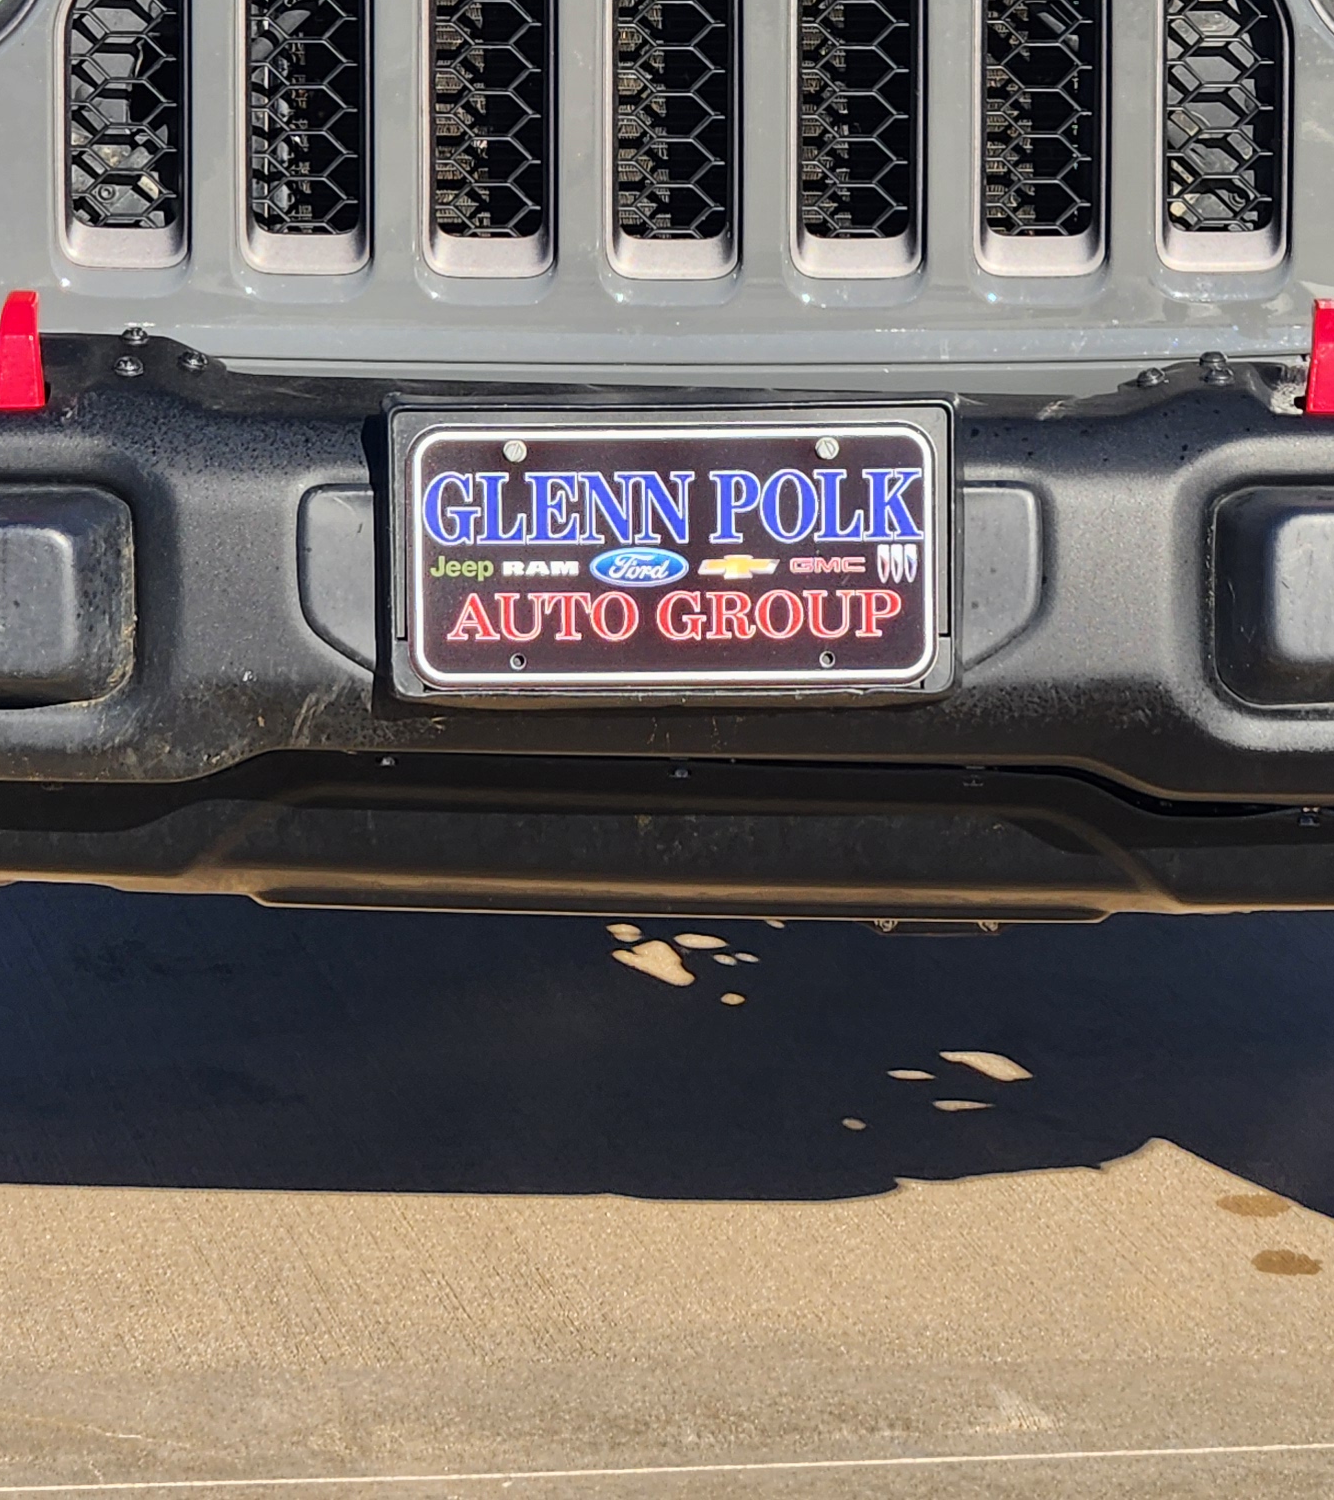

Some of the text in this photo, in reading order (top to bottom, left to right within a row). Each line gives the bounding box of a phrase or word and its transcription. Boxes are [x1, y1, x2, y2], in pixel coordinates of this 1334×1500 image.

[422, 467, 925, 547] GLENN POLK
[430, 553, 867, 581] Jeep RAM Ford GMC
[446, 589, 902, 642] AUTO GROUP
